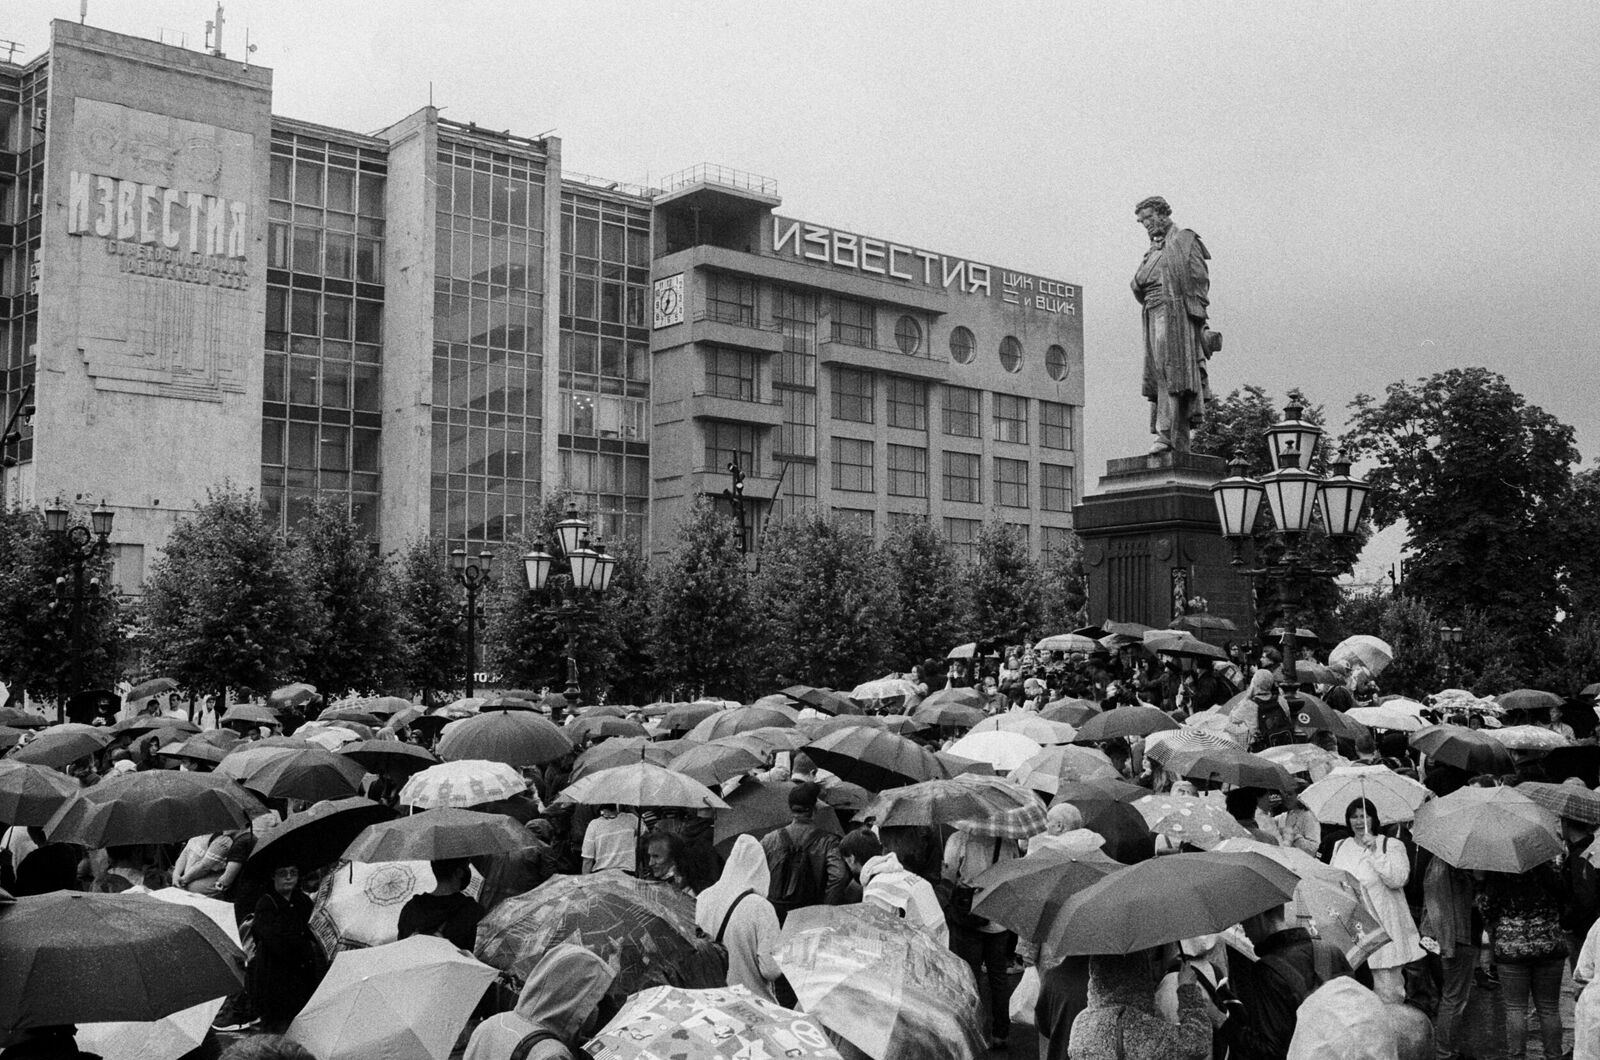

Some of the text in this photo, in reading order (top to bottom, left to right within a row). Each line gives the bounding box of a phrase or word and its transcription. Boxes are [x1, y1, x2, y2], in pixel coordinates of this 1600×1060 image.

[68, 171, 247, 258] ИЗВЕСТИЯ
[774, 216, 991, 297] ИЗВЕСТИЯ
[1002, 272, 1075, 298] ЦИК СССР
[1036, 295, 1075, 316] ВЦИК
